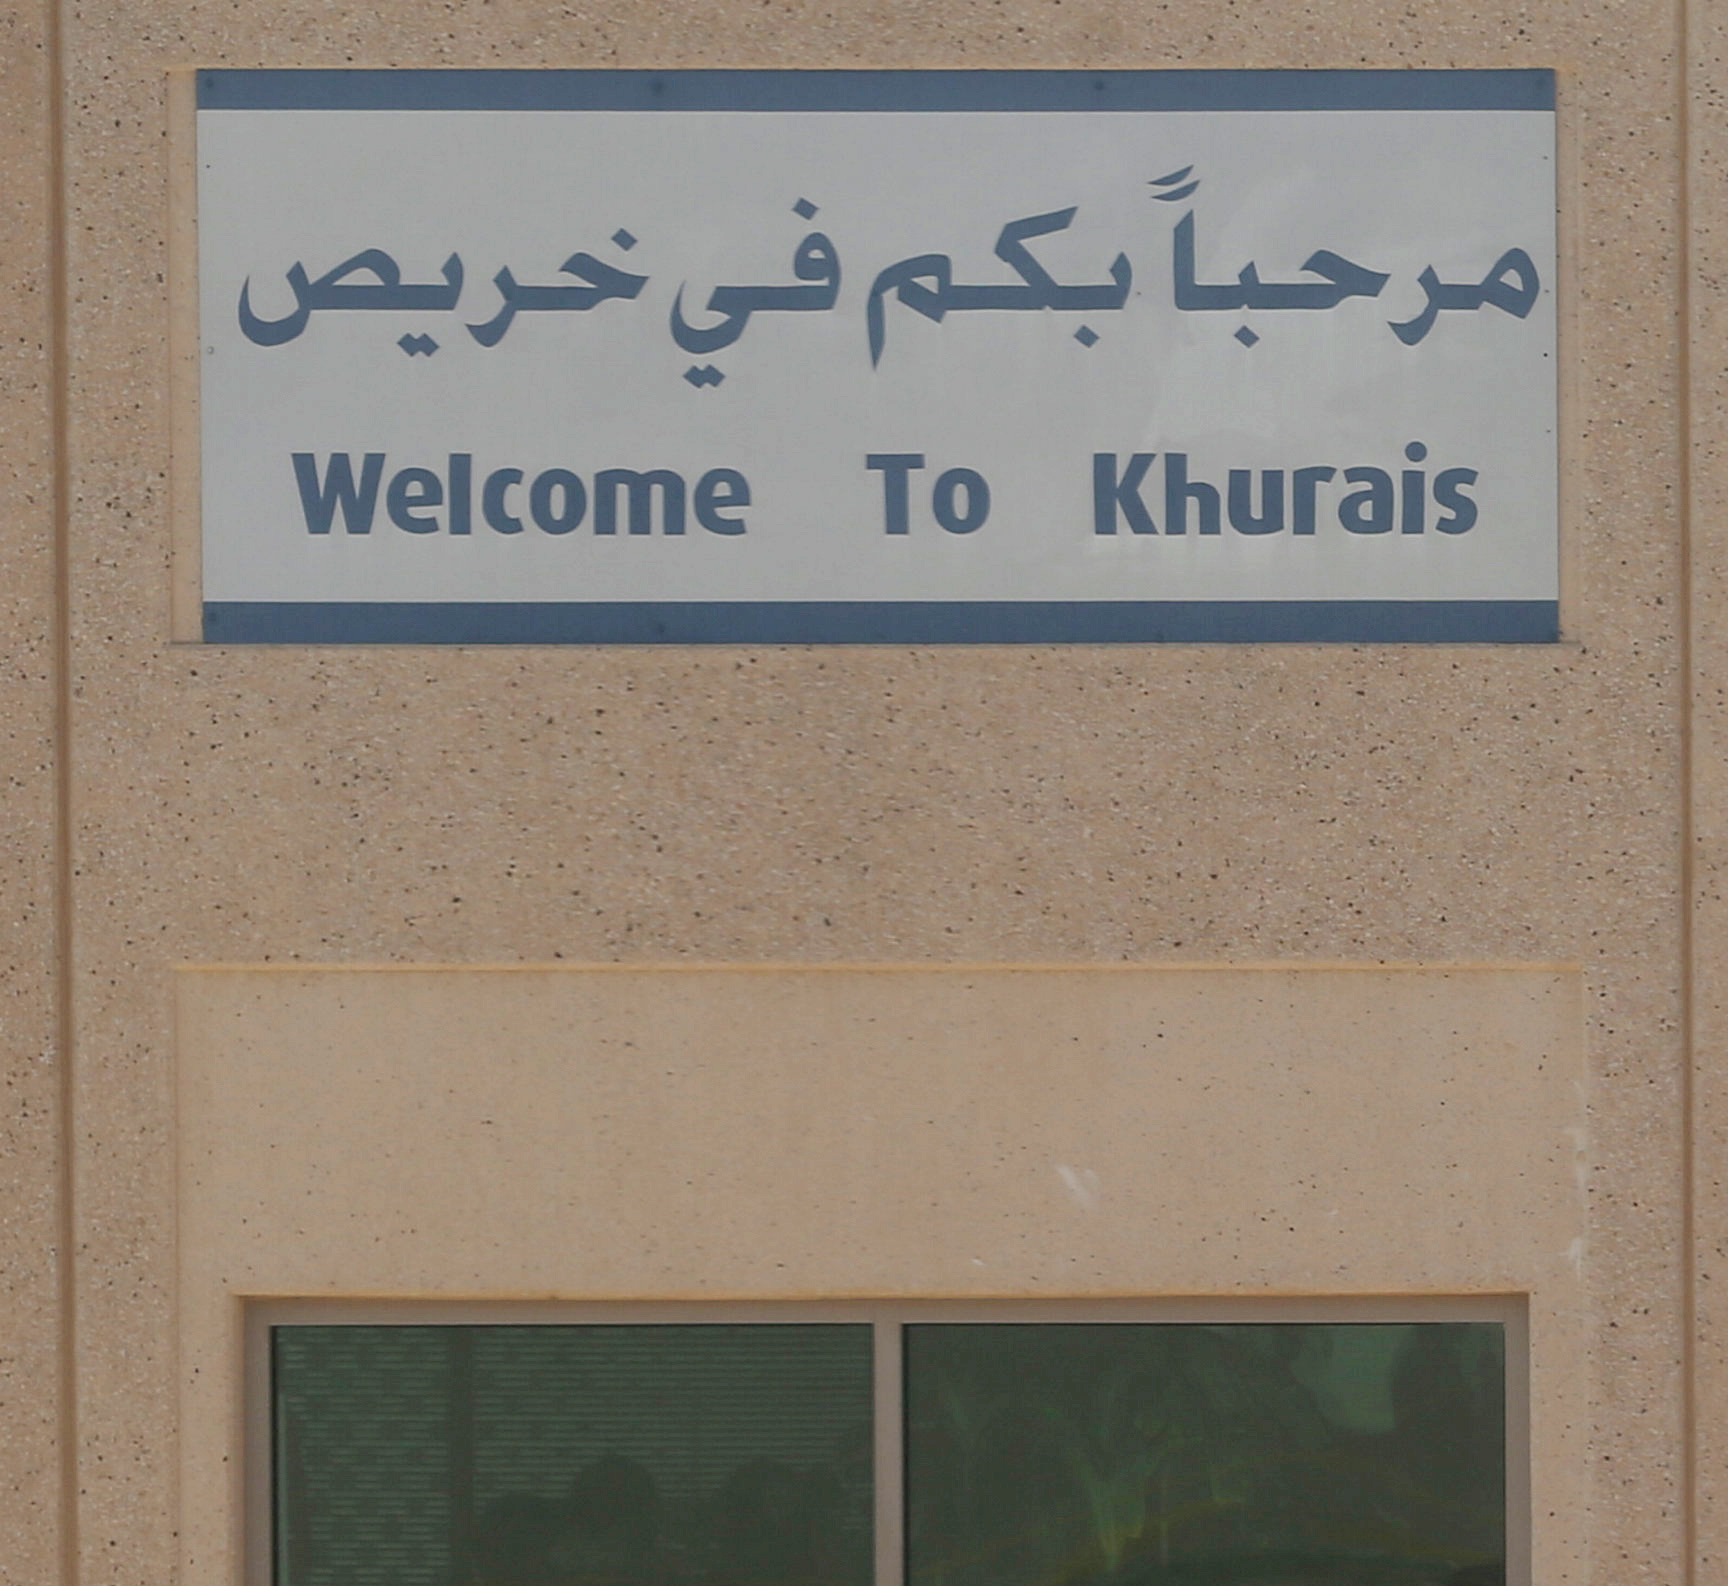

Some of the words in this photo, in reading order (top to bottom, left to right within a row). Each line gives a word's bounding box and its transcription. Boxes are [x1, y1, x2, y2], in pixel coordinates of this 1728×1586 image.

[237, 227, 650, 357] خريص
[669, 197, 842, 389] في
[866, 206, 1133, 369] بكم
[290, 452, 752, 536] Welcome
[865, 453, 991, 536] To
[1092, 441, 1479, 536] Khurais
